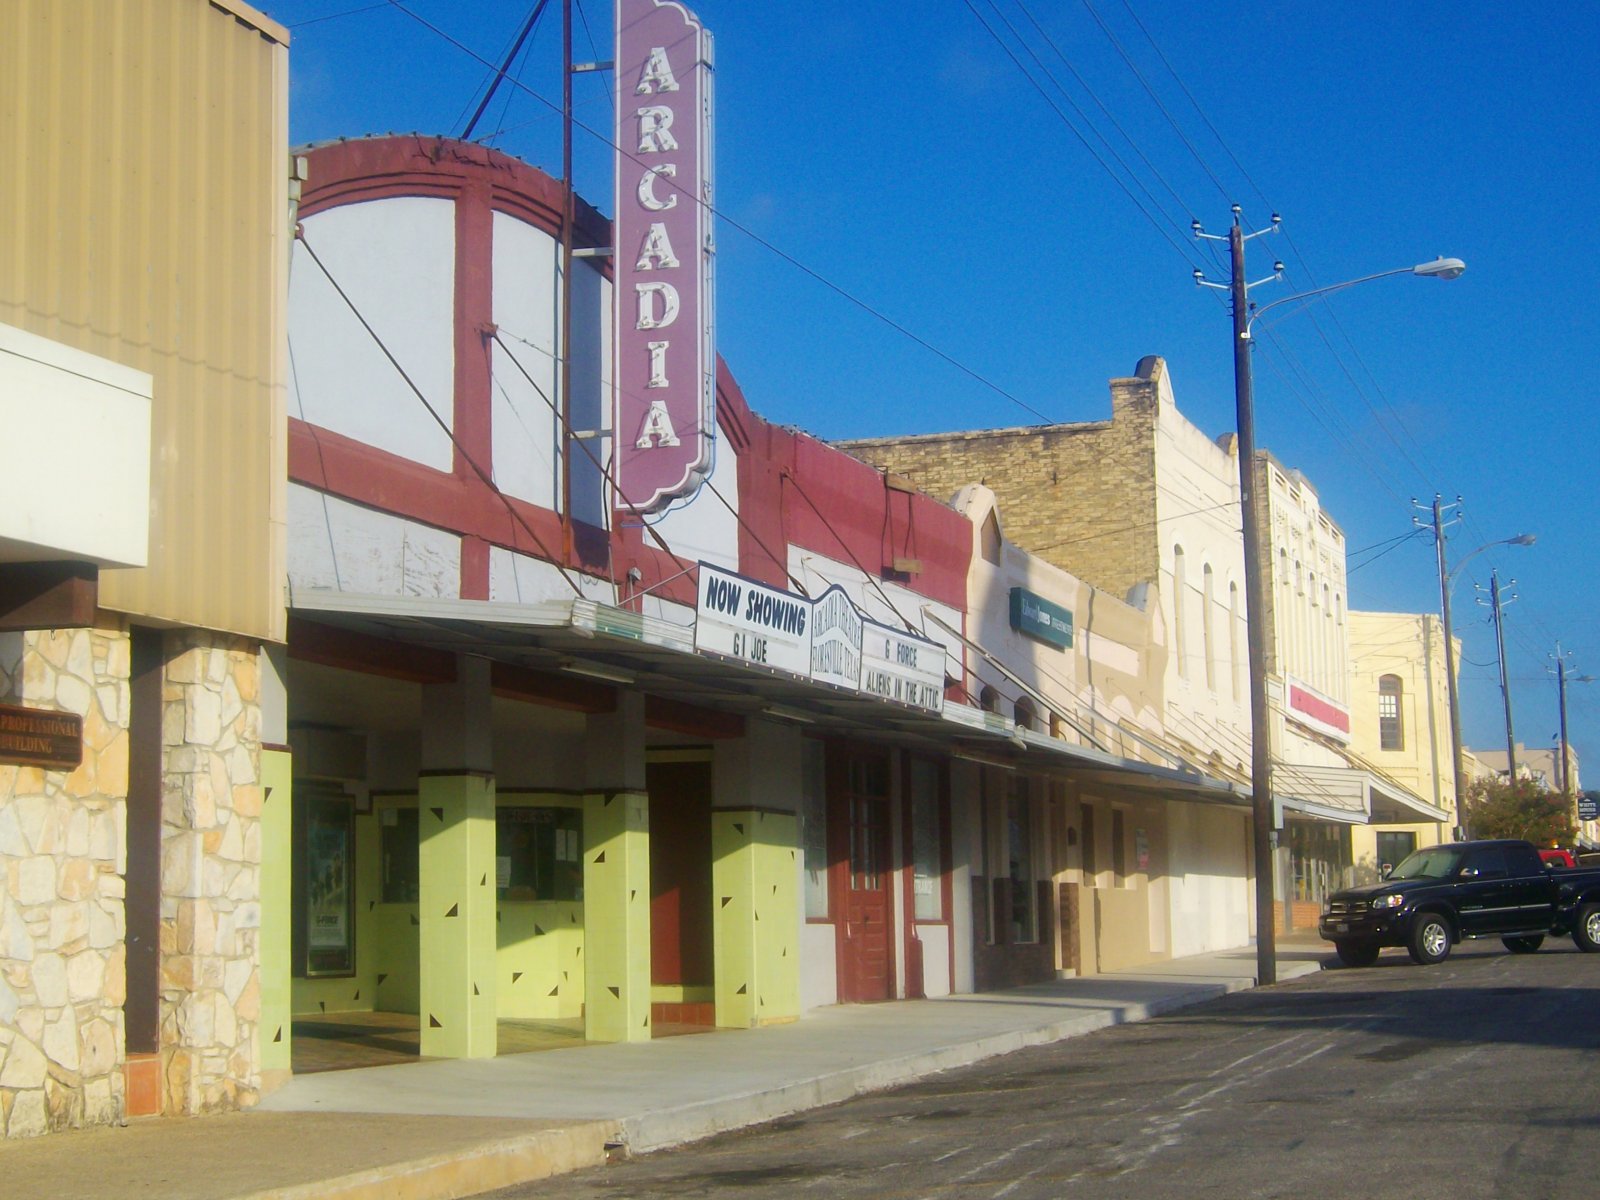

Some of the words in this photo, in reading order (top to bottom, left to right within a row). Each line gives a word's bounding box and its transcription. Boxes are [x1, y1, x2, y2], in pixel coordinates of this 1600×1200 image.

[635, 47, 680, 449] ARCADIA
[706, 576, 741, 617] NOW
[746, 590, 806, 637] SHOWING
[814, 592, 837, 638] ARCADIA
[1037, 605, 1051, 626] Jones
[733, 633, 740, 656] G
[742, 634, 746, 657] I
[751, 637, 767, 663] JOE
[885, 639, 891, 659] G
[897, 642, 917, 668] FORCE
[866, 671, 891, 696] ALIENS
[895, 677, 902, 700] IN
[906, 681, 917, 704] THE
[920, 686, 939, 709] ATTIC
[1, 714, 78, 737] PROFESSIONAL
